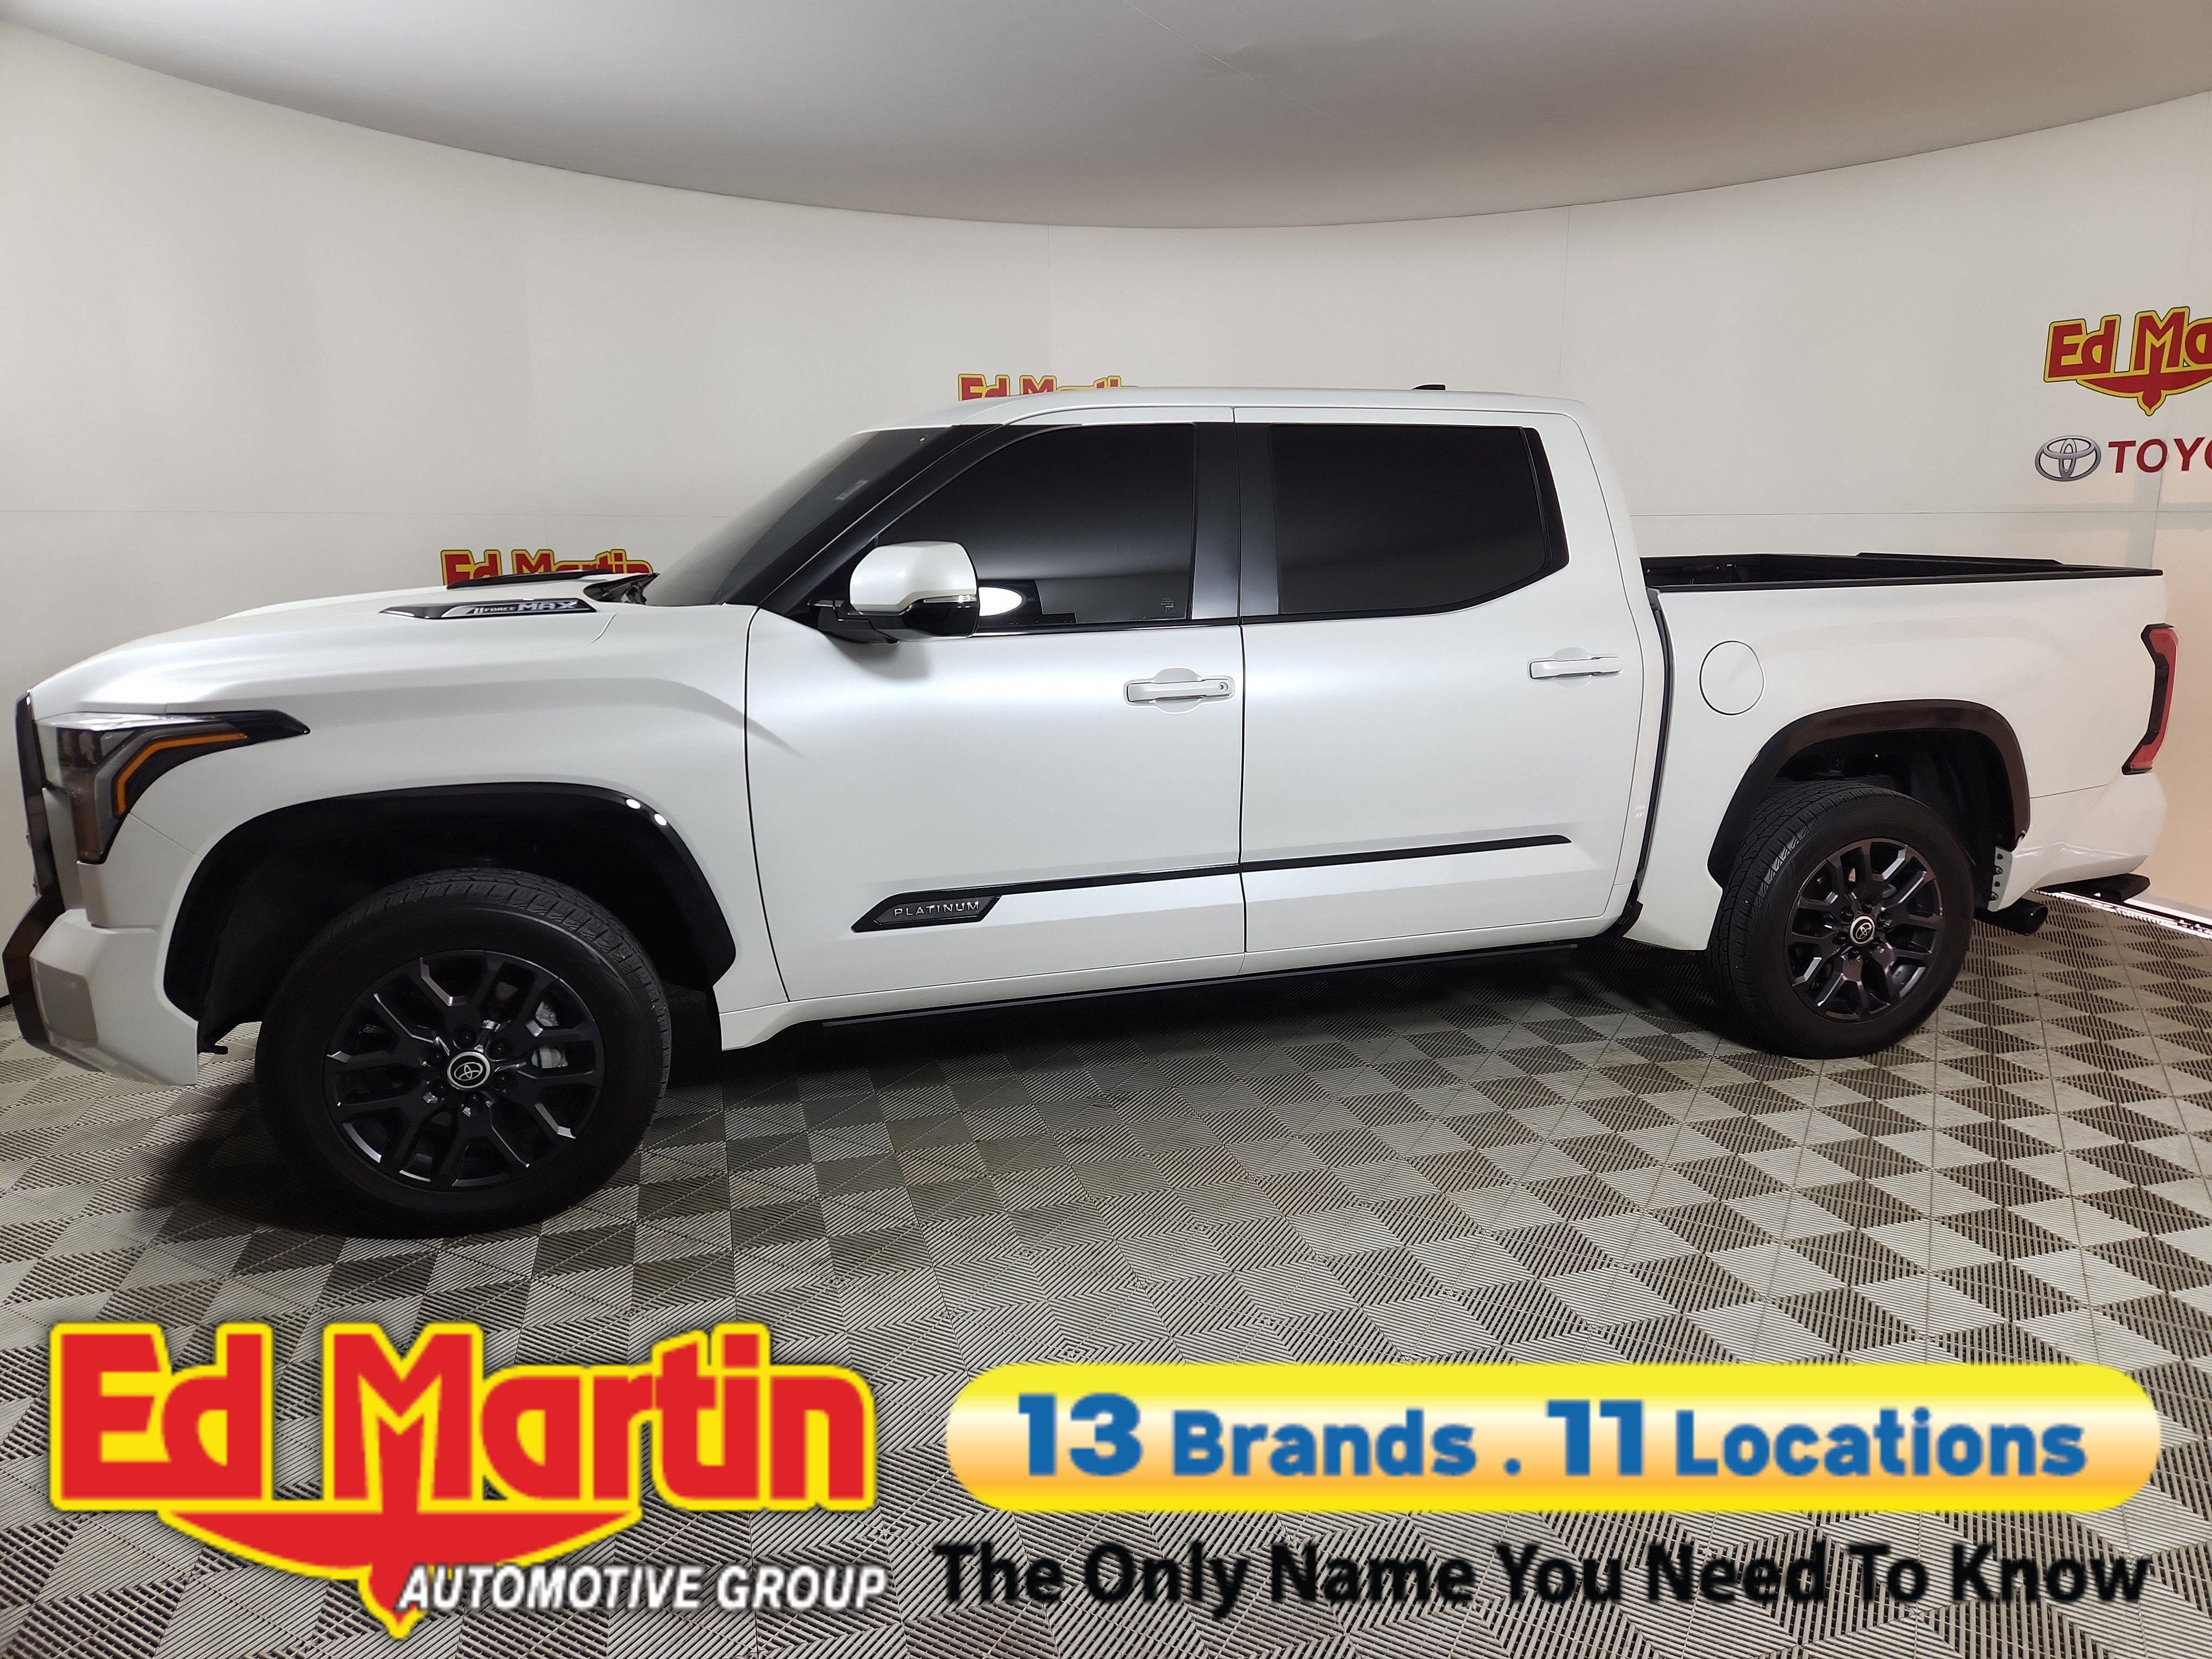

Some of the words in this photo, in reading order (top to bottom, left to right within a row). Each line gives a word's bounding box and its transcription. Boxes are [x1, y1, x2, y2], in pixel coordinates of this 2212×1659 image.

[2044, 316, 2121, 381] Ed
[2108, 437, 2212, 473] TOY
[512, 550, 653, 575] Mti
[517, 600, 578, 612] MAX
[894, 901, 979, 917] PLATINUM
